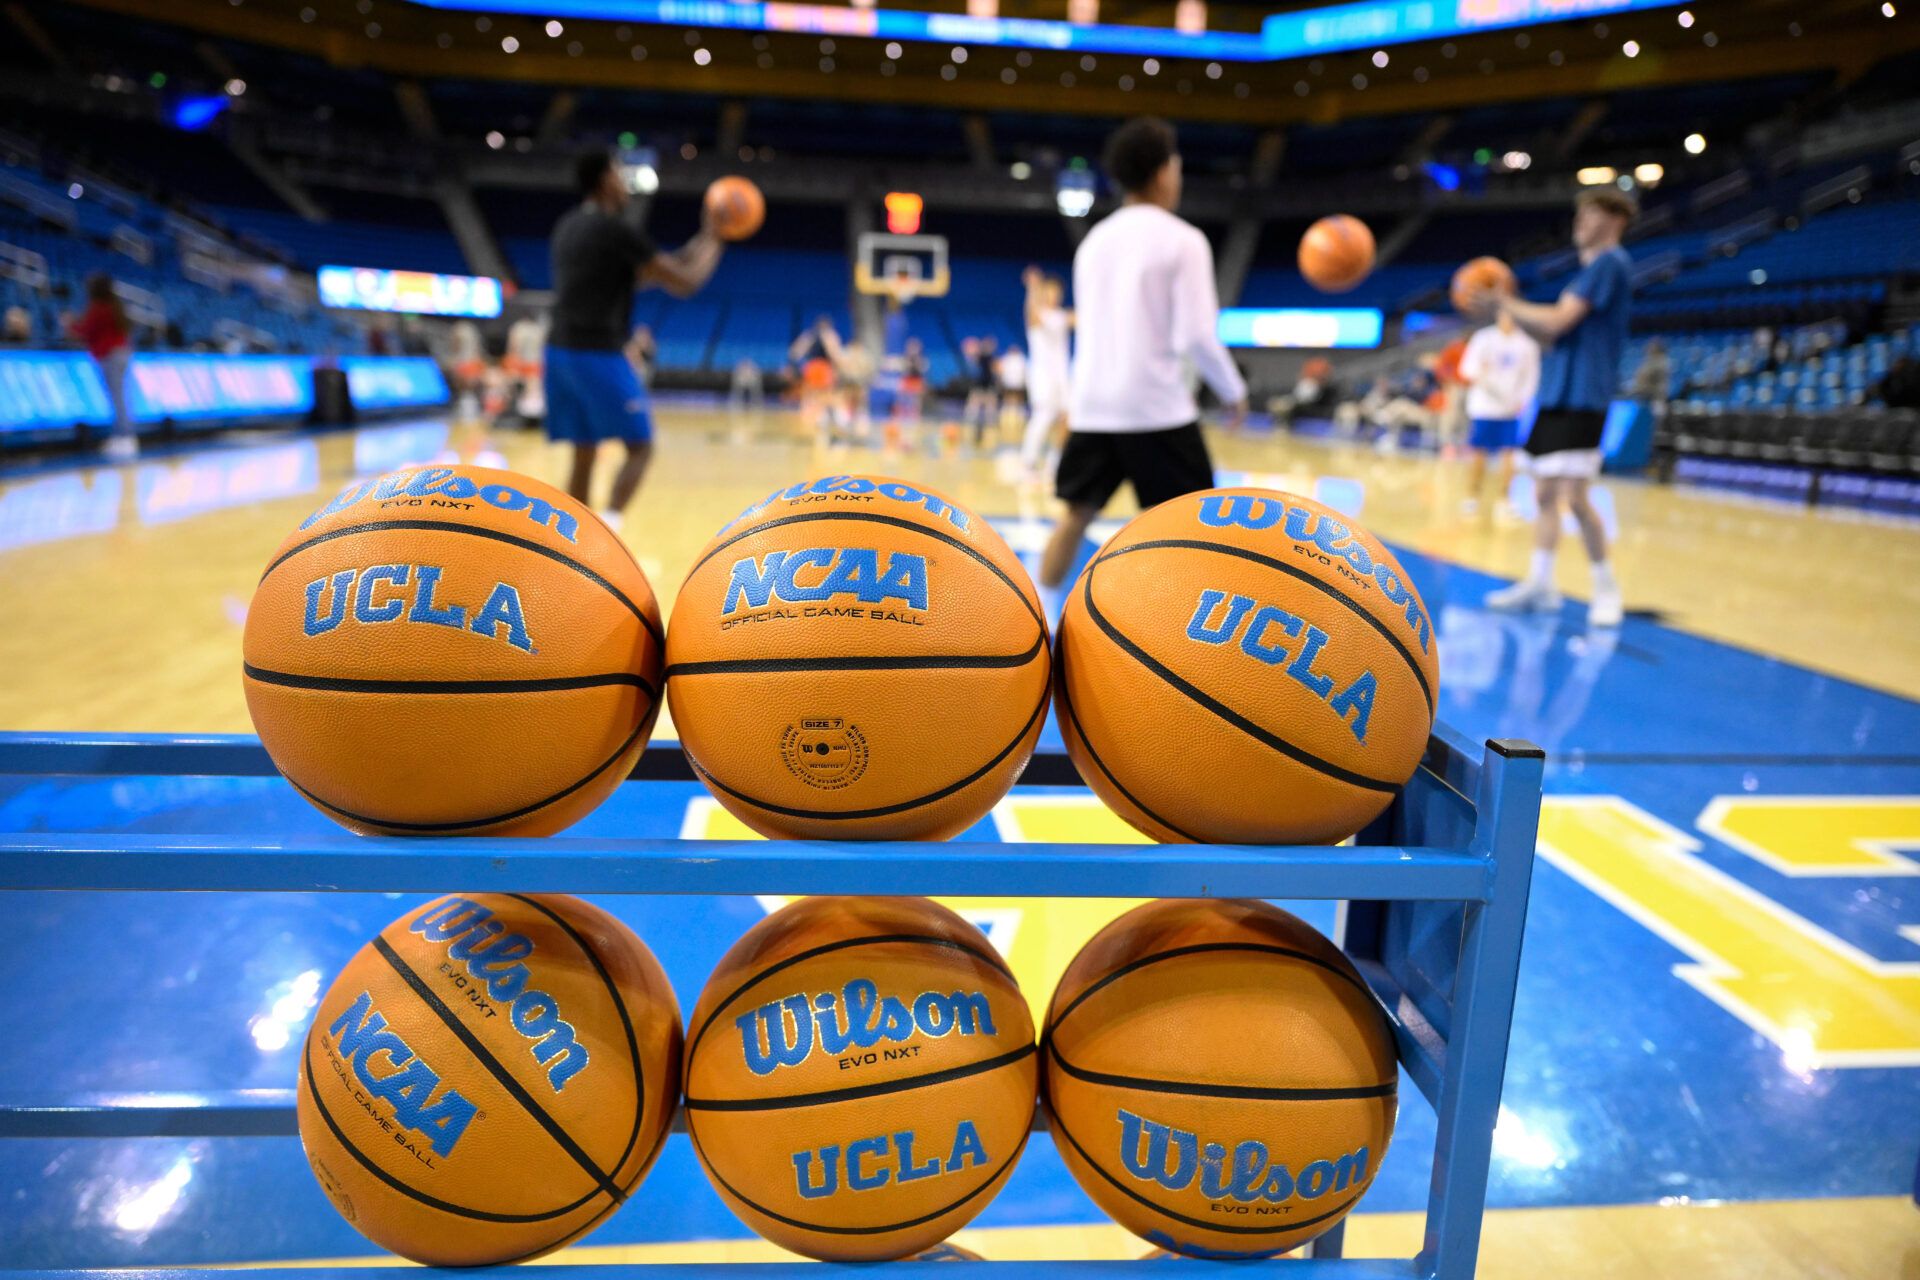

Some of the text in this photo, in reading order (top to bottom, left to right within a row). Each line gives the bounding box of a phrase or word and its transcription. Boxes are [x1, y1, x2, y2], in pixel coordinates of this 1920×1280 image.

[381, 499, 475, 511] EVO NXT
[716, 475, 971, 537] ilson
[789, 494, 874, 506] EVO NXT
[720, 548, 929, 616] NCAA
[1198, 496, 1432, 657] Wilson
[1293, 545, 1372, 591] EVO NXT
[303, 563, 536, 655] UCLA
[721, 608, 924, 631] OFFICIAL GAME BALL
[1186, 588, 1378, 747] UCLA
[408, 896, 590, 1094] Wilson
[439, 962, 498, 1020] EVO NXT
[735, 978, 999, 1077] Wilson
[329, 990, 479, 1160] NCAA
[838, 1046, 922, 1071] EVO NXT
[320, 1034, 437, 1171] OFFICIAL GAME BALL
[792, 1120, 990, 1200] UCLA
[1116, 1108, 1369, 1204] Wilson
[1211, 1204, 1294, 1216] EVO NXT
